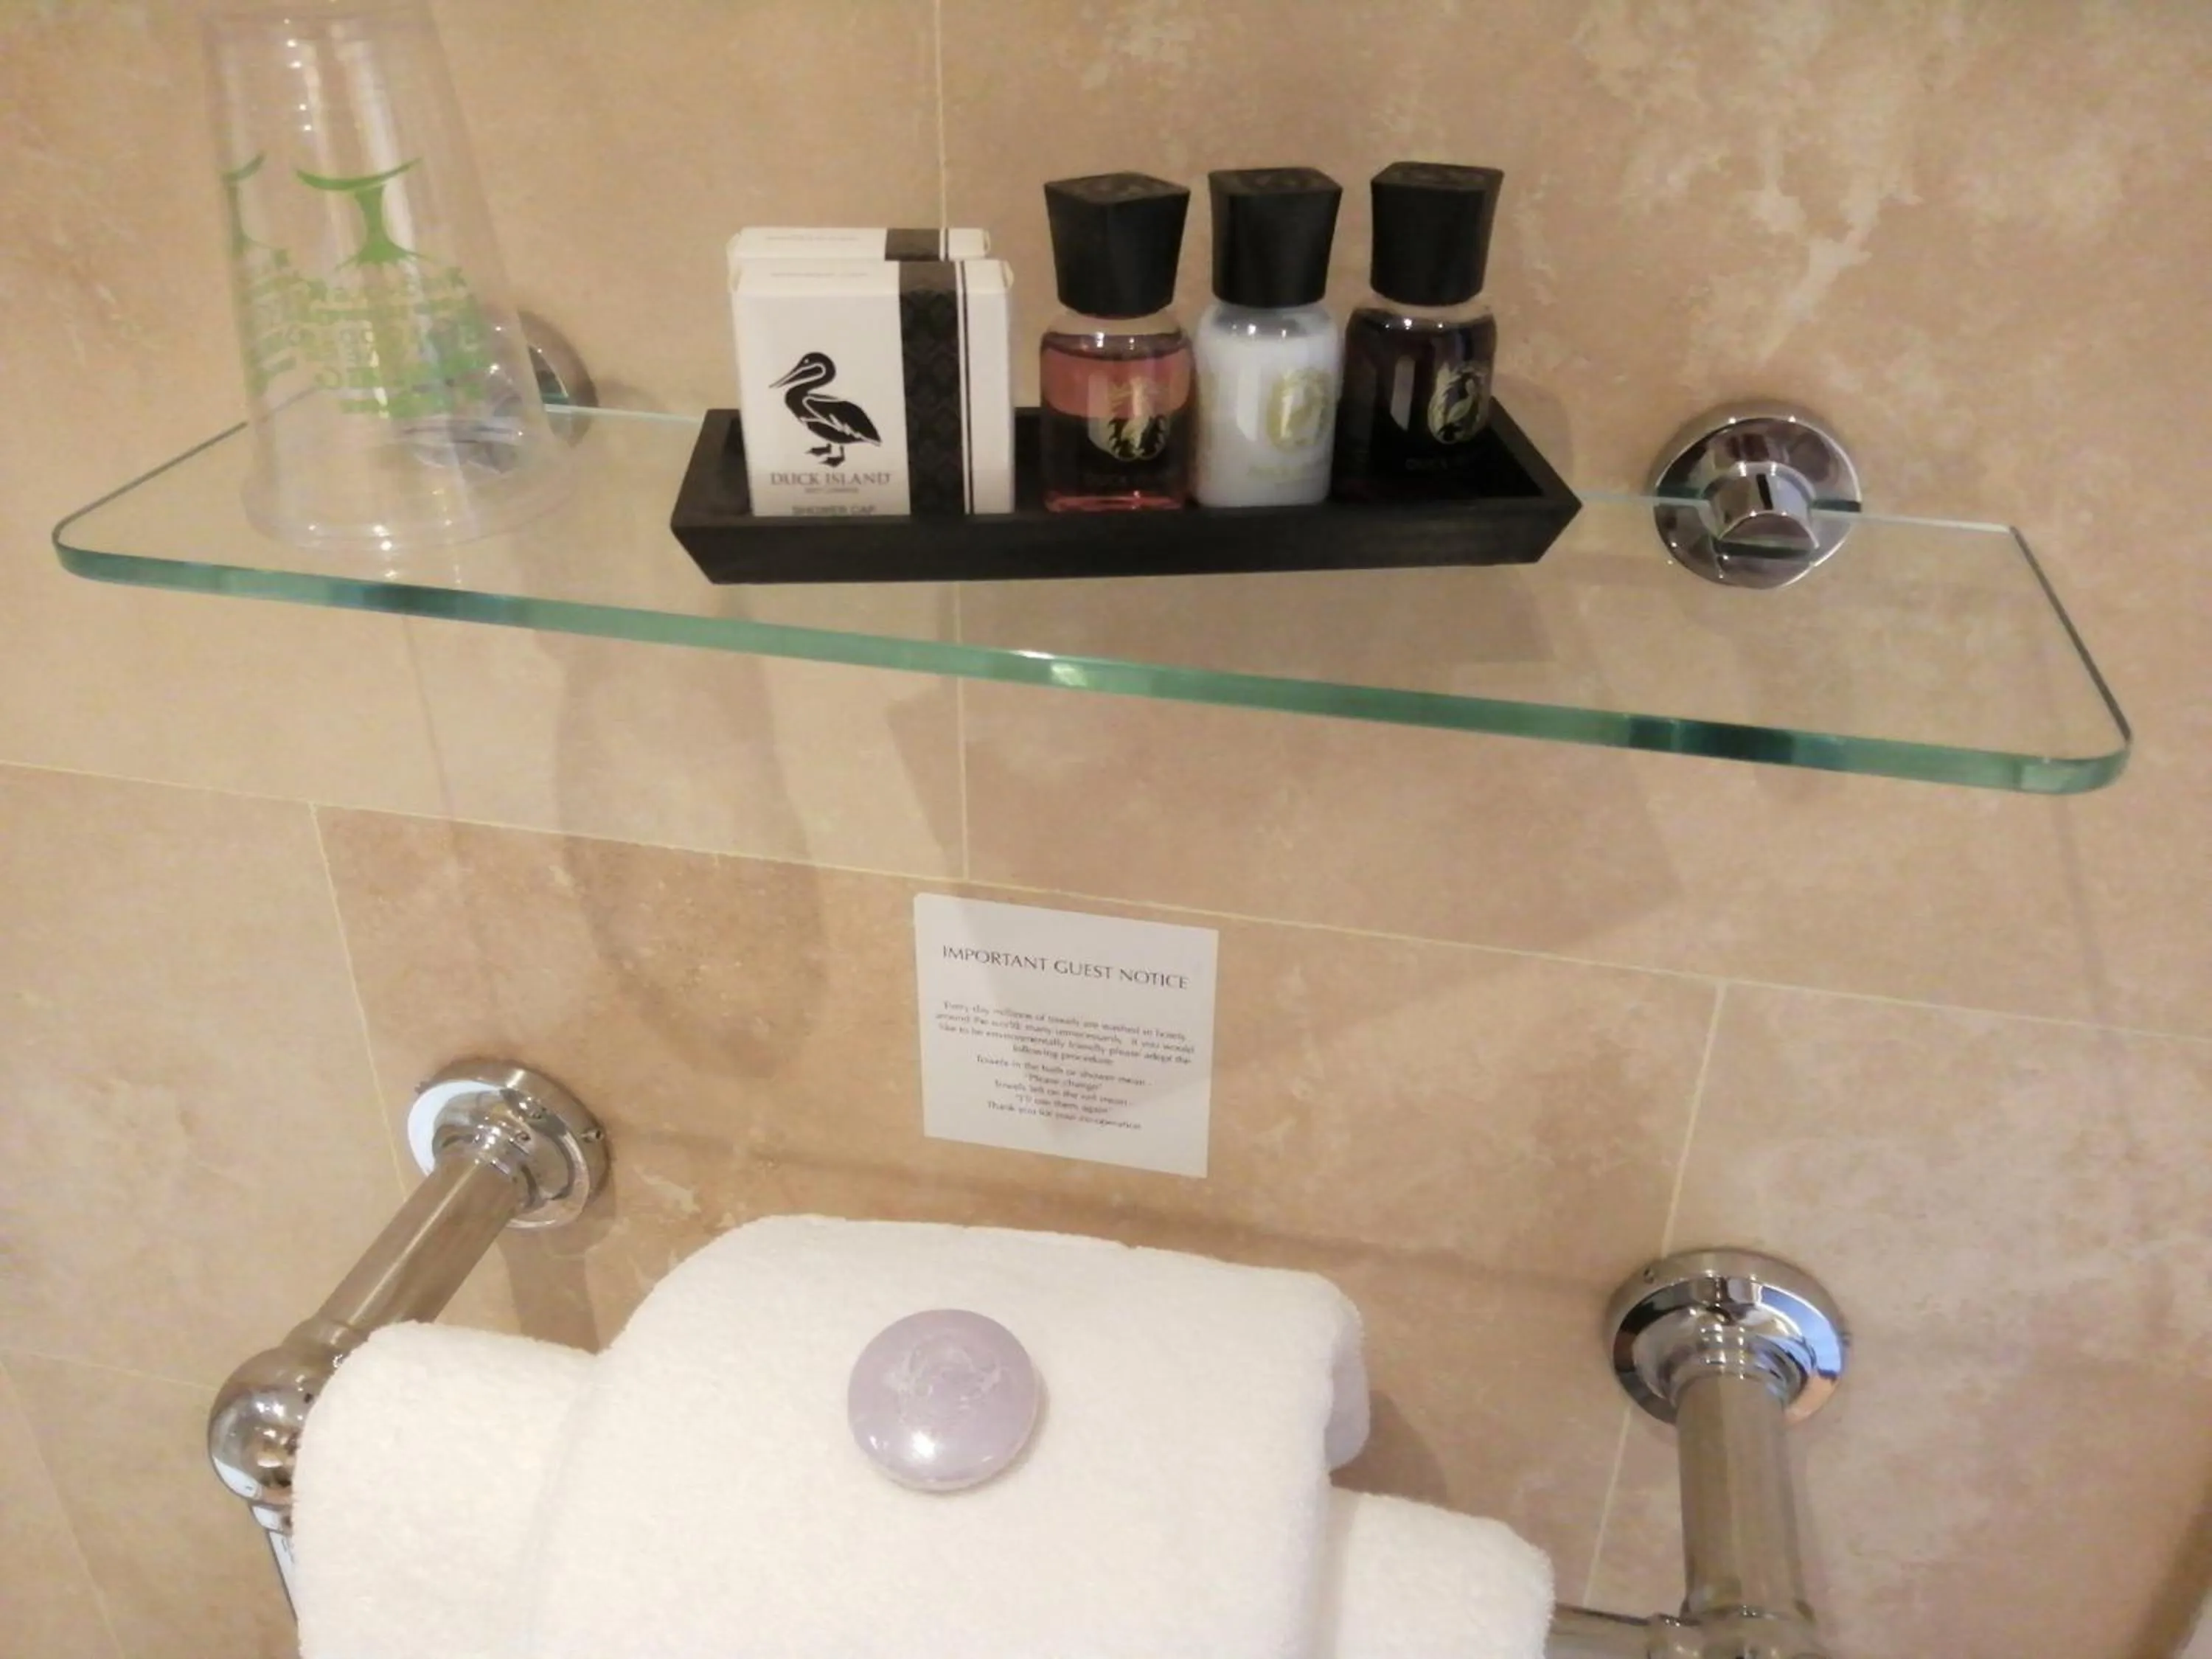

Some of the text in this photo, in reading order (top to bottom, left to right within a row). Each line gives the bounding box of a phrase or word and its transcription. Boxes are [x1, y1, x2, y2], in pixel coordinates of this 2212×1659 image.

[770, 471, 891, 485] DUCK ISLAND
[942, 945, 1190, 990] IMPORTANT GUEST NOTICE
